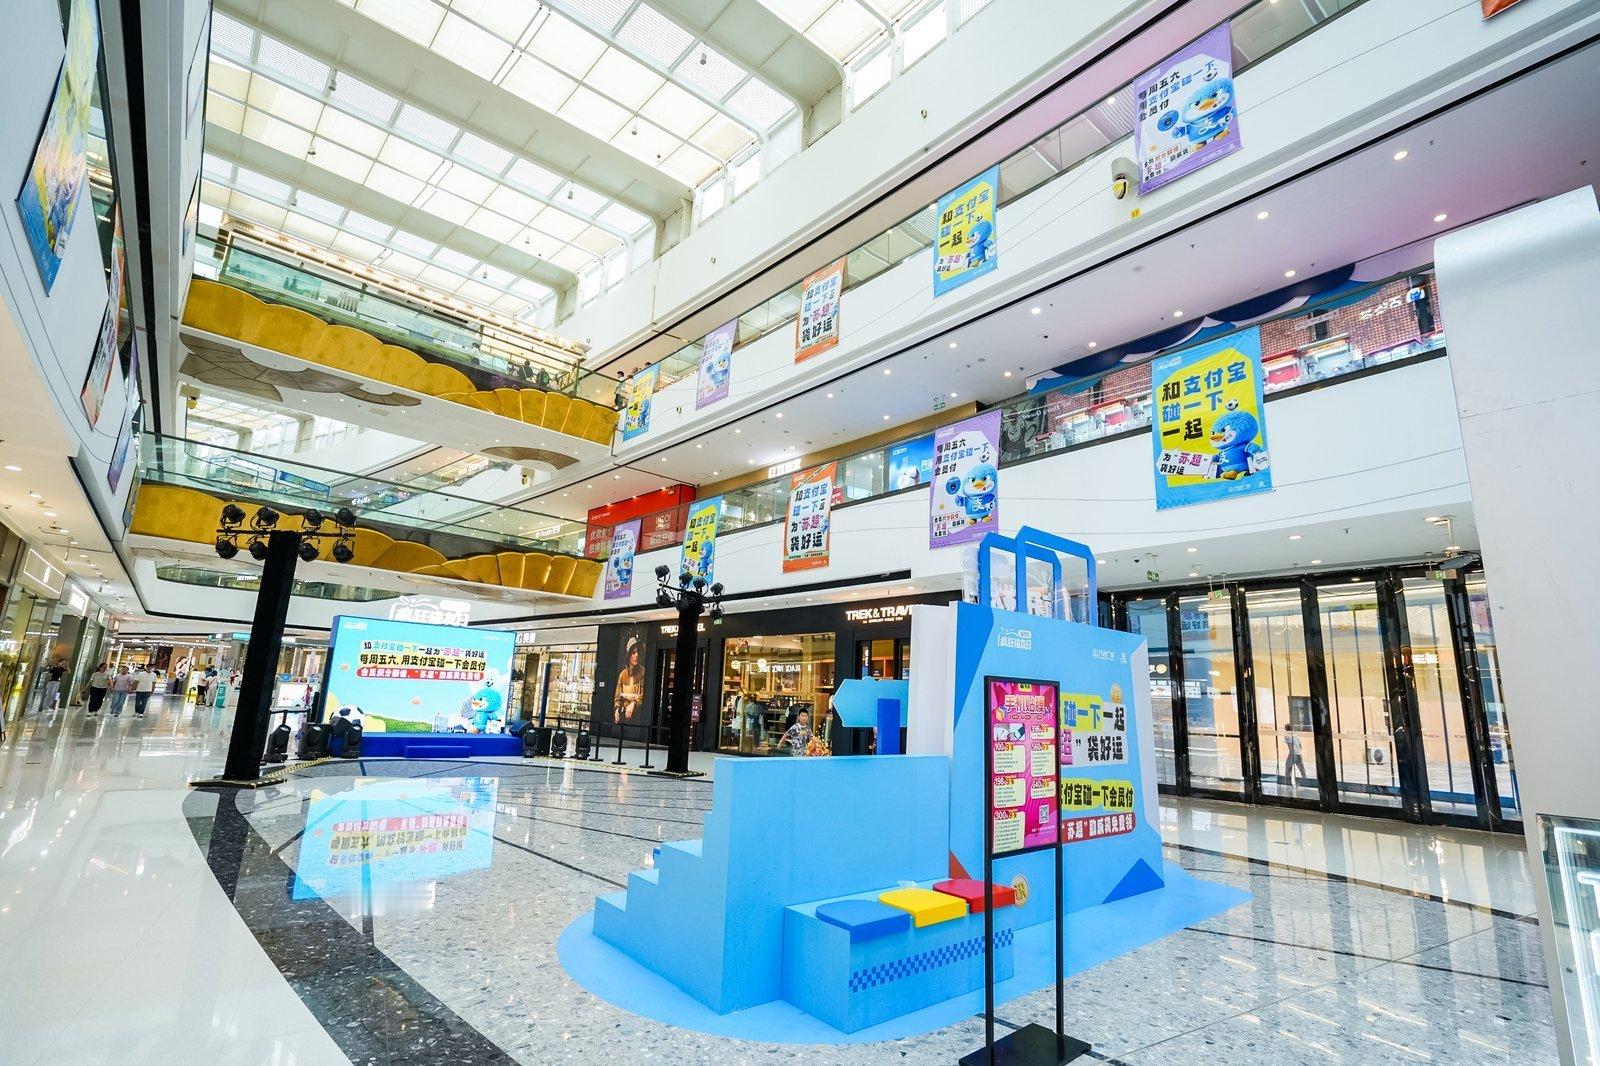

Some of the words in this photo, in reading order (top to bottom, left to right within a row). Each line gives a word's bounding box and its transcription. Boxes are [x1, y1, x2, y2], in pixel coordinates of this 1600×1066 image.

[941, 188, 989, 225] 和支付宝
[940, 210, 975, 239] 碰一下
[939, 231, 963, 248] 一起
[802, 317, 832, 343] 袋好运
[1162, 360, 1247, 402] 和支付宝
[1162, 390, 1223, 423] 碰一下
[1162, 417, 1204, 442] 一起
[935, 442, 990, 466] 用支付宝碰一下
[936, 438, 967, 453] 每周五六
[934, 463, 957, 476] 会员付
[795, 483, 829, 502] 和支付宝
[790, 532, 824, 552] 袋好运
[1063, 700, 1125, 732] 碰一下一起
